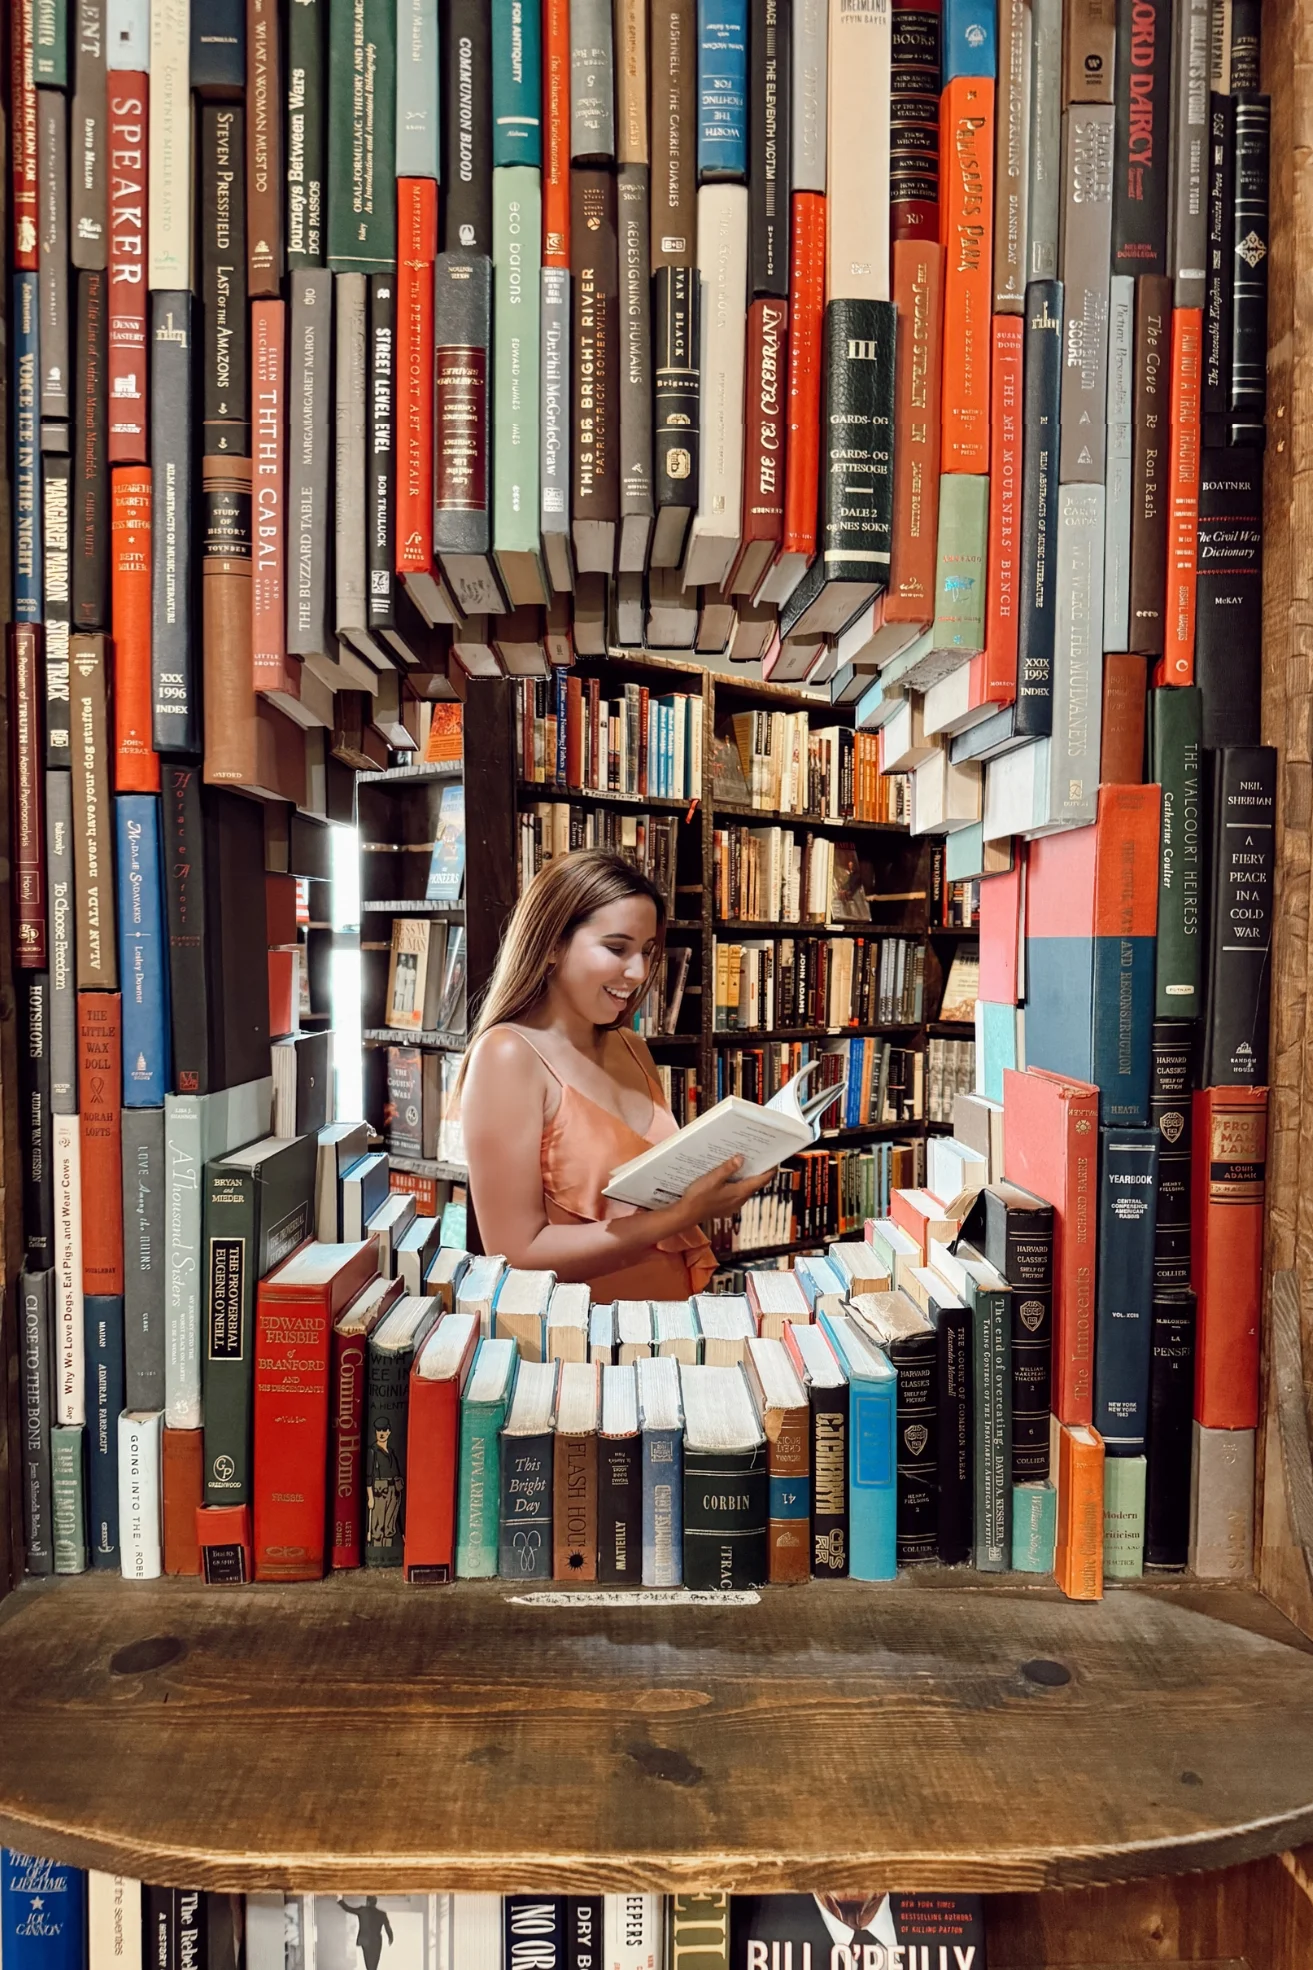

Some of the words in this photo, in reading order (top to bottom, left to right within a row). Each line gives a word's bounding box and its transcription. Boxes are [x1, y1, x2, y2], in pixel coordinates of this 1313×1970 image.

[459, 38, 473, 131] COMMUNION
[713, 80, 733, 88] FOR
[766, 59, 776, 80] THE
[288, 68, 305, 111] Wars
[765, 83, 776, 137] ELEVENTH
[1127, 73, 1155, 168] DARCY
[217, 113, 233, 166] STEVEN
[288, 114, 305, 182] Between
[704, 128, 740, 137] WORTH
[459, 134, 473, 181] BLOOD
[765, 140, 776, 180] VICTIM
[111, 97, 142, 285] SPEAKER
[217, 171, 233, 249] PRESSFIELD
[287, 186, 306, 254] Journeys
[508, 202, 522, 234] eco
[217, 266, 233, 297] LAST
[508, 243, 523, 304] barons
[627, 221, 641, 315] REDESIGNING
[217, 297, 226, 307] OF
[581, 268, 594, 326] RIVER
[217, 309, 226, 325] THE
[1147, 315, 1161, 345] The
[217, 326, 234, 388] AMAZONS
[375, 328, 391, 376] STREET
[629, 321, 643, 384] HUMANS
[1067, 320, 1082, 367] SCORE
[581, 336, 594, 408] BRIGHT
[1145, 353, 1160, 394] Cove
[375, 380, 390, 419] LEVEL
[580, 452, 594, 496] THIS
[1145, 449, 1159, 477] Ron
[1144, 483, 1157, 519] Rash
[1202, 482, 1252, 491] BOATNER
[45, 478, 68, 549] MARGARET
[299, 486, 313, 531] TABLE
[841, 508, 870, 517] DALE
[871, 508, 877, 517] 2
[258, 488, 278, 572] CABAL
[299, 534, 313, 598] BUZZARD
[1201, 546, 1255, 559] Dictionary
[46, 552, 68, 601] MARON
[299, 602, 313, 631] THE
[46, 620, 69, 659] STORM
[47, 662, 69, 702] TRACK
[160, 673, 184, 684] XXX
[1024, 670, 1049, 680] 1995
[158, 688, 187, 699] 1996
[1020, 687, 1050, 696] INDEX
[81, 697, 94, 744] stuffed
[156, 705, 188, 714] INDEX
[82, 746, 97, 770] dog
[1184, 743, 1198, 771] THE
[84, 771, 96, 803] your
[1240, 782, 1263, 791] NEIL
[85, 804, 97, 837] have
[1163, 792, 1175, 845] Catherine
[1184, 779, 1197, 865] VALCOURT
[88, 839, 99, 878] never
[1163, 848, 1174, 888] Coulter
[1232, 854, 1265, 864] FIERY
[21, 876, 33, 900] Hanly
[54, 882, 67, 896] To
[1229, 872, 1266, 882] PEACE
[87, 886, 100, 926] ALDA
[1183, 871, 1198, 935] HEIRESS
[1230, 908, 1265, 919] COLD
[54, 899, 67, 939] Choose
[1234, 928, 1261, 938] WAR
[89, 929, 101, 970] ALAN
[134, 946, 144, 971] Lesley
[1120, 941, 1133, 967] AND
[55, 941, 67, 990] Freedom
[135, 973, 144, 1004] Downer
[29, 985, 43, 1058] HOTSHOTS
[86, 1011, 108, 1021] THE
[1118, 972, 1133, 1075] RECONSTRUCTION
[85, 1042, 110, 1052] WAX
[85, 1059, 111, 1069] DOLL
[31, 1091, 41, 1127] JUDITH
[31, 1129, 42, 1146] VAN
[32, 1148, 43, 1183] GIESON
[60, 1159, 70, 1188] Cows
[1076, 1157, 1088, 1192] BARRE
[1109, 1174, 1153, 1185] YEARBOOK
[214, 1178, 243, 1187] BRYAN
[61, 1191, 71, 1217] Wear
[170, 1170, 199, 1248] Thousand
[212, 1194, 244, 1203] MIEDER
[61, 1220, 71, 1239] and
[1076, 1196, 1089, 1244] RICHARD
[61, 1242, 73, 1269] Pigs,
[227, 1247, 238, 1272] THE
[1017, 1245, 1048, 1254] HARVARD
[62, 1272, 72, 1288] Eat
[170, 1252, 196, 1307] Sisters
[214, 1249, 226, 1297] EUGENE
[24, 1295, 39, 1343] CLOSE
[63, 1291, 74, 1321] Dogs,
[227, 1274, 238, 1351] PROVERBIAL
[994, 1300, 1005, 1323] The
[1071, 1267, 1090, 1363] Innocents
[63, 1325, 72, 1350] Love
[214, 1300, 227, 1348] O'NEILL
[260, 1316, 325, 1330] EDWARD
[266, 1331, 320, 1344] FRISBIE
[982, 1319, 990, 1349] TAKING
[994, 1329, 1005, 1352] end
[26, 1347, 39, 1369] TO
[63, 1353, 72, 1368] We
[258, 1359, 325, 1370] BRANFORD
[900, 1367, 930, 1378] HARVARD
[983, 1351, 991, 1388] CONTROL
[995, 1357, 1006, 1372] of
[27, 1373, 40, 1405] THE
[63, 1372, 74, 1395] Why
[335, 1347, 363, 1429] Coming
[901, 1378, 930, 1389] CLASSICS
[958, 1391, 965, 1399] OF
[983, 1391, 991, 1401] OF
[1074, 1368, 1089, 1398] The
[983, 1403, 991, 1418] THE
[994, 1374, 1006, 1449] overeating.
[28, 1408, 40, 1450] BONE
[984, 1420, 992, 1467] INSATIABLE
[130, 1435, 139, 1475] GOING
[337, 1434, 360, 1498] Home
[516, 1459, 541, 1471] This
[567, 1443, 584, 1498] FLASH
[958, 1450, 966, 1480] PLEAS
[131, 1481, 140, 1511] INTO
[508, 1479, 547, 1492] Bright
[984, 1469, 992, 1510] AMERICAN
[514, 1499, 541, 1513] Day
[702, 1495, 750, 1510] CORBIN
[132, 1516, 141, 1539] THE
[134, 1552, 144, 1577] ROBE
[10, 1876, 68, 1892] LIFETIME
[180, 1892, 200, 1925] The
[511, 1903, 556, 1935] NO
[901, 1914, 942, 1922] BESTSELLING
[944, 1914, 973, 1922] AUTHORS
[114, 1907, 123, 1956] seventies
[576, 1906, 592, 1947] DRY
[912, 1926, 936, 1934] KILLING
[938, 1926, 964, 1935] PATTON
